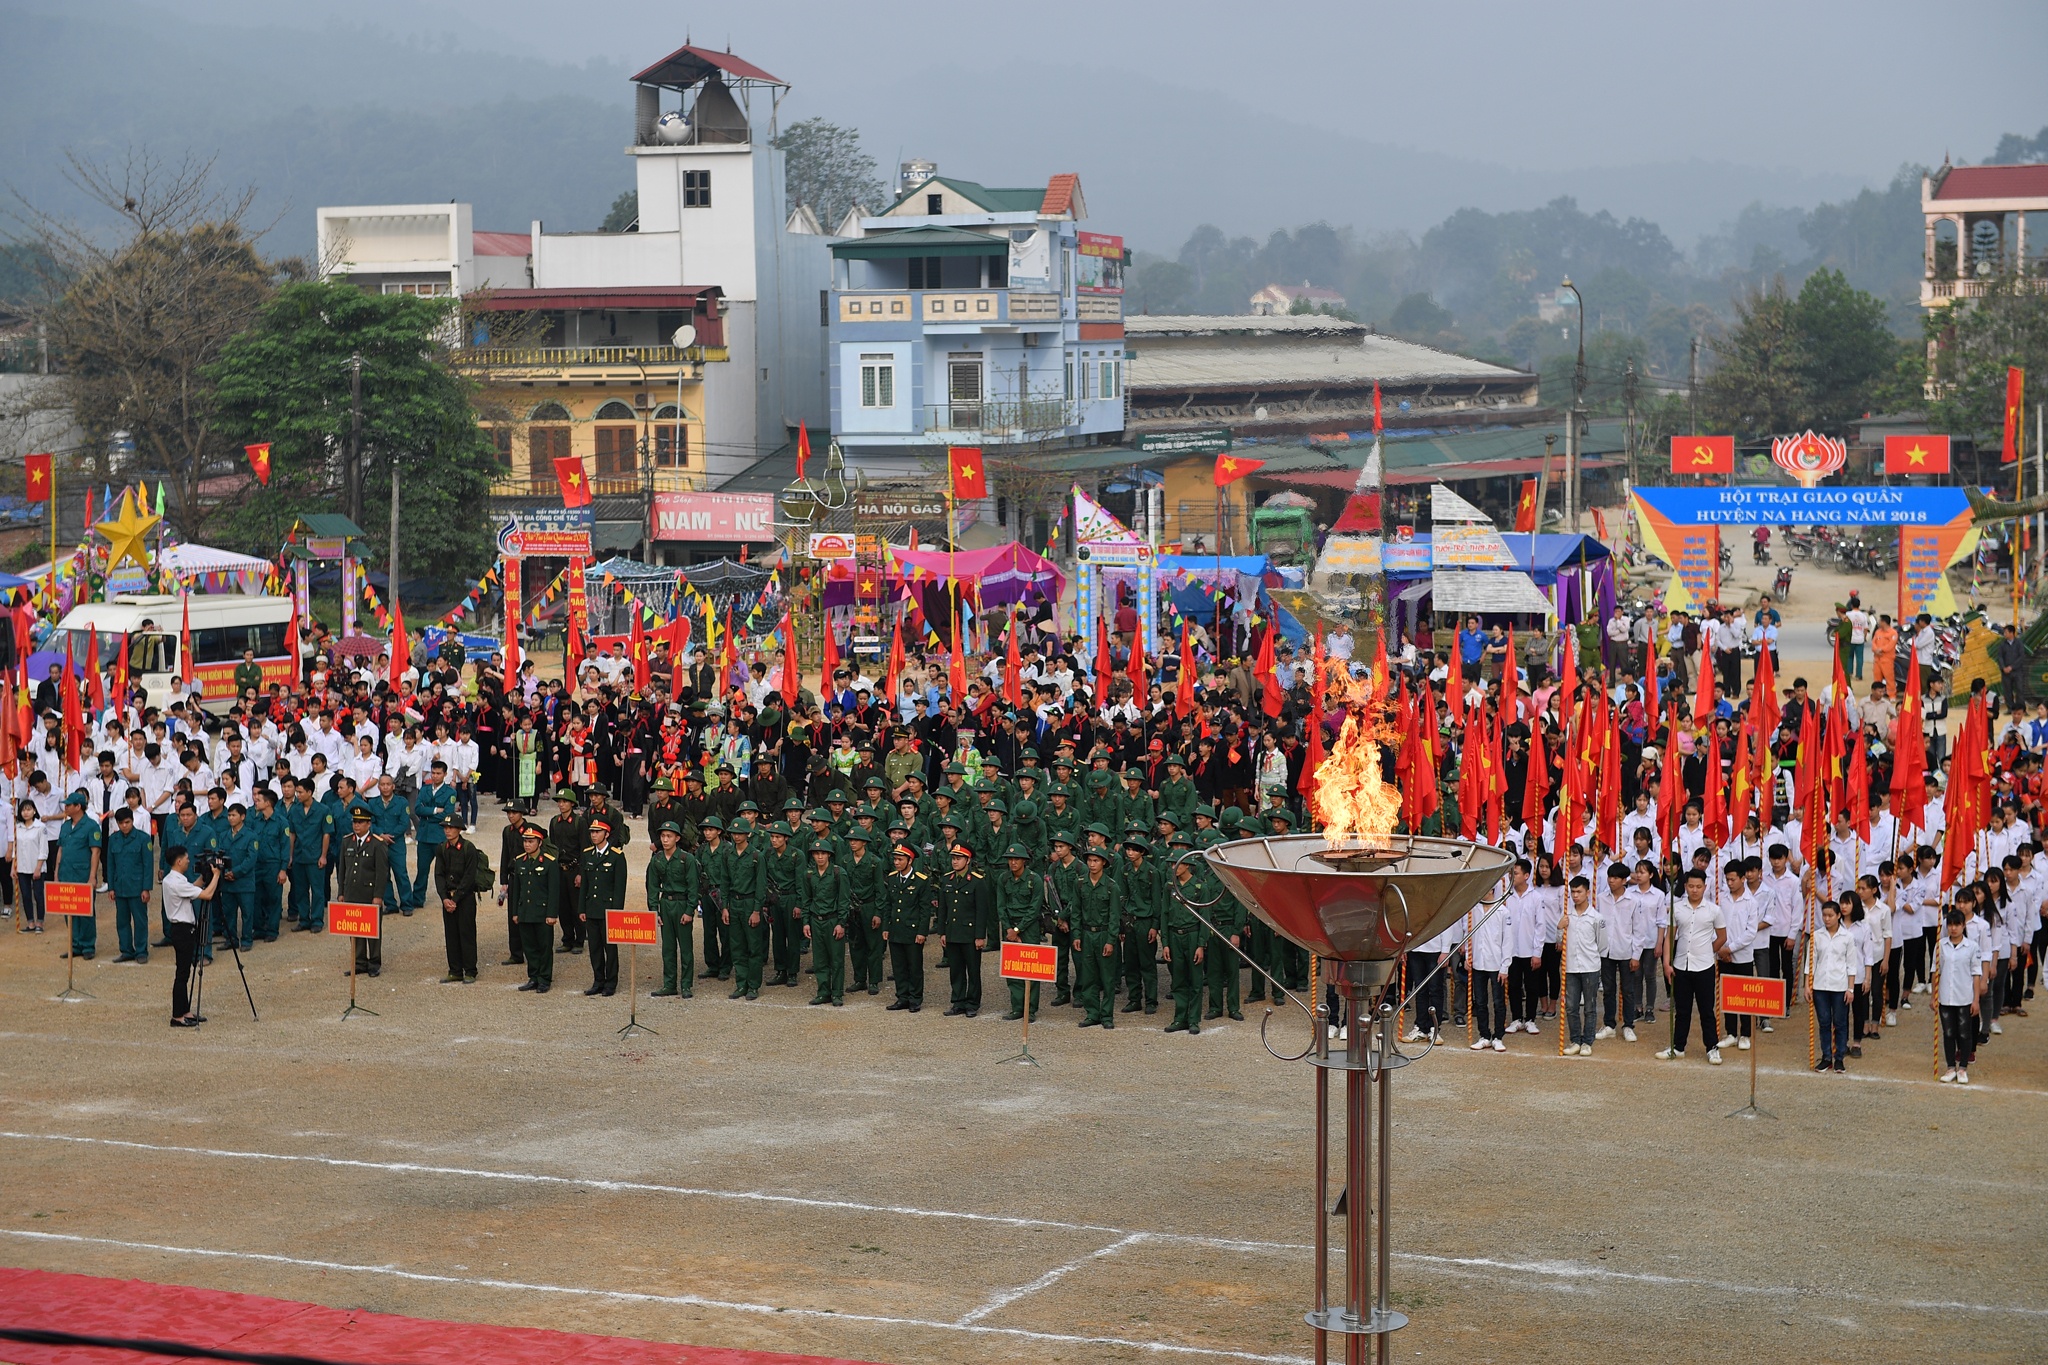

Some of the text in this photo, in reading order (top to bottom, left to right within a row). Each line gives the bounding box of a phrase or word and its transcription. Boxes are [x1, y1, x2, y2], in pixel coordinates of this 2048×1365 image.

[673, 495, 692, 505] Shop
[1720, 488, 1903, 505] HỘI TRẠI GIAO QUÂN
[858, 502, 942, 515] HÀ NỘI GAS
[1696, 507, 1927, 523] HUYỆN NA HANG NĂM 2018
[566, 513, 578, 521] TÁC
[660, 511, 711, 530] NAM
[735, 508, 770, 531] NỮ
[573, 533, 586, 541] 2018
[346, 908, 361, 917] KHỐI
[336, 919, 370, 932] CÔNG AN
[623, 915, 640, 924] KHỐI
[608, 928, 614, 938] SƯ
[615, 927, 624, 938] ĐOÀN
[633, 928, 643, 940] QUÂN
[1020, 950, 1038, 959] KHỐI
[1004, 960, 1011, 970] SƯ
[1012, 959, 1023, 971] ĐOÀN
[1031, 961, 1042, 973] QUÂN
[1043, 964, 1051, 974] KHU
[1743, 983, 1764, 993] KHỐI
[1727, 994, 1779, 1010] TRƯỜNG THPT NA HANG
